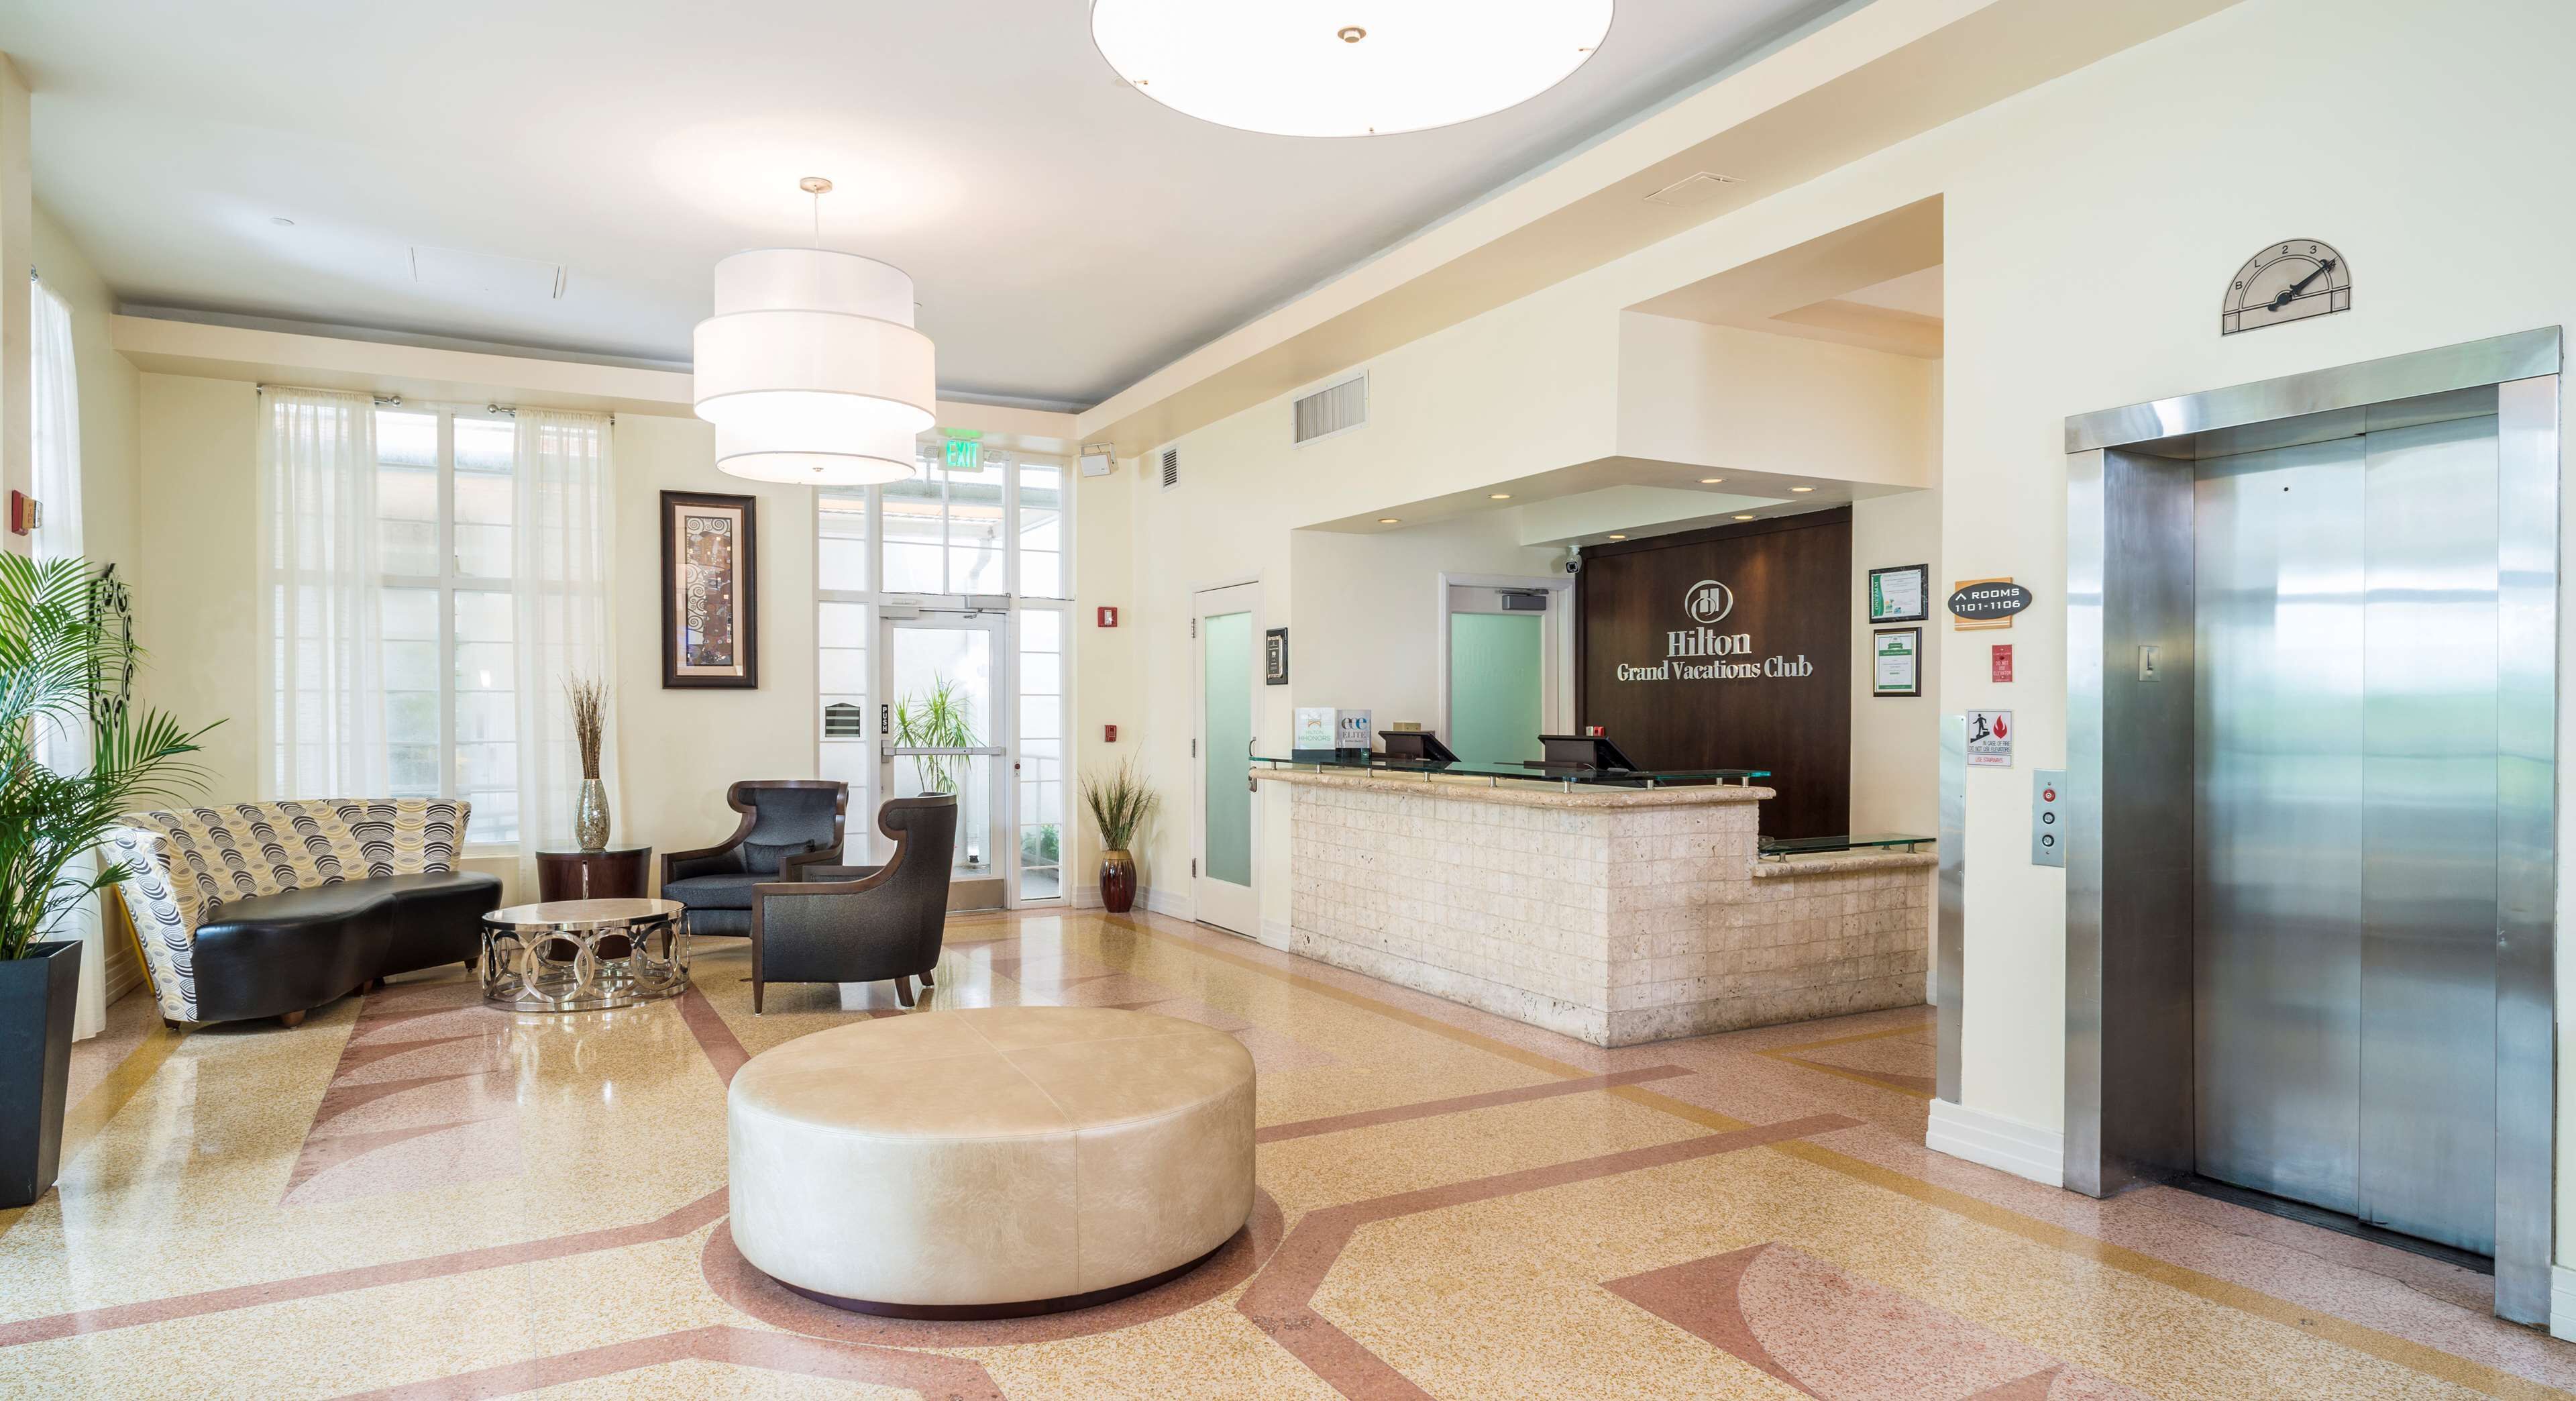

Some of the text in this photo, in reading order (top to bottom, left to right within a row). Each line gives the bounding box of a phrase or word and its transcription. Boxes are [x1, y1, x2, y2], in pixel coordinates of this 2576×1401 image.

[2235, 281, 2243, 290] B
[2254, 260, 2261, 268] L
[2282, 245, 2289, 254] 2
[2310, 245, 2317, 254] 3
[946, 439, 977, 468] EXIT
[1955, 600, 2021, 612] 1101-1106
[1972, 588, 2020, 599] ROOMS
[1666, 627, 1752, 658] Hilton
[1617, 655, 1813, 681] Grand Vacations Club
